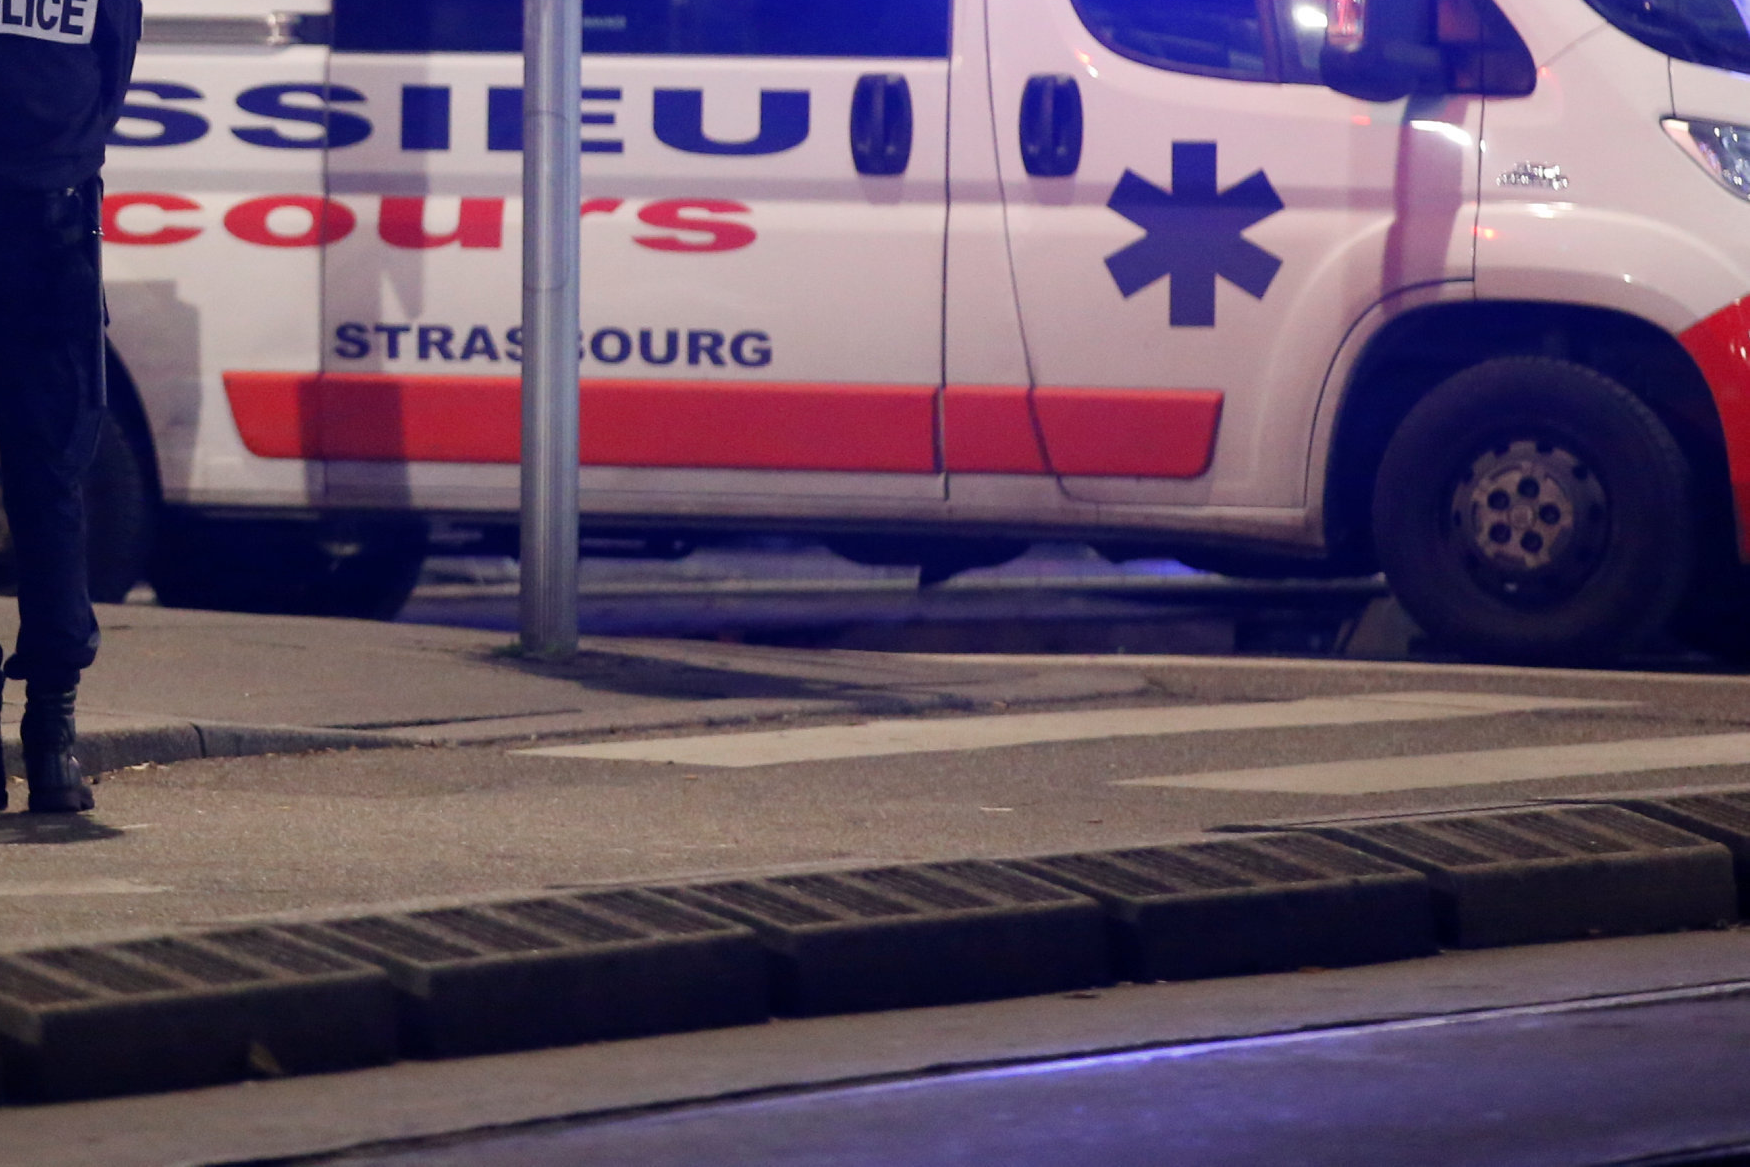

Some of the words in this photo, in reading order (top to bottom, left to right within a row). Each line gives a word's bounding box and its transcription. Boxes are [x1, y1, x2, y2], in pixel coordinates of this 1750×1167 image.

[105, 82, 810, 155] SSIEU
[102, 192, 757, 253] cous
[335, 322, 773, 368] STRAOURG
